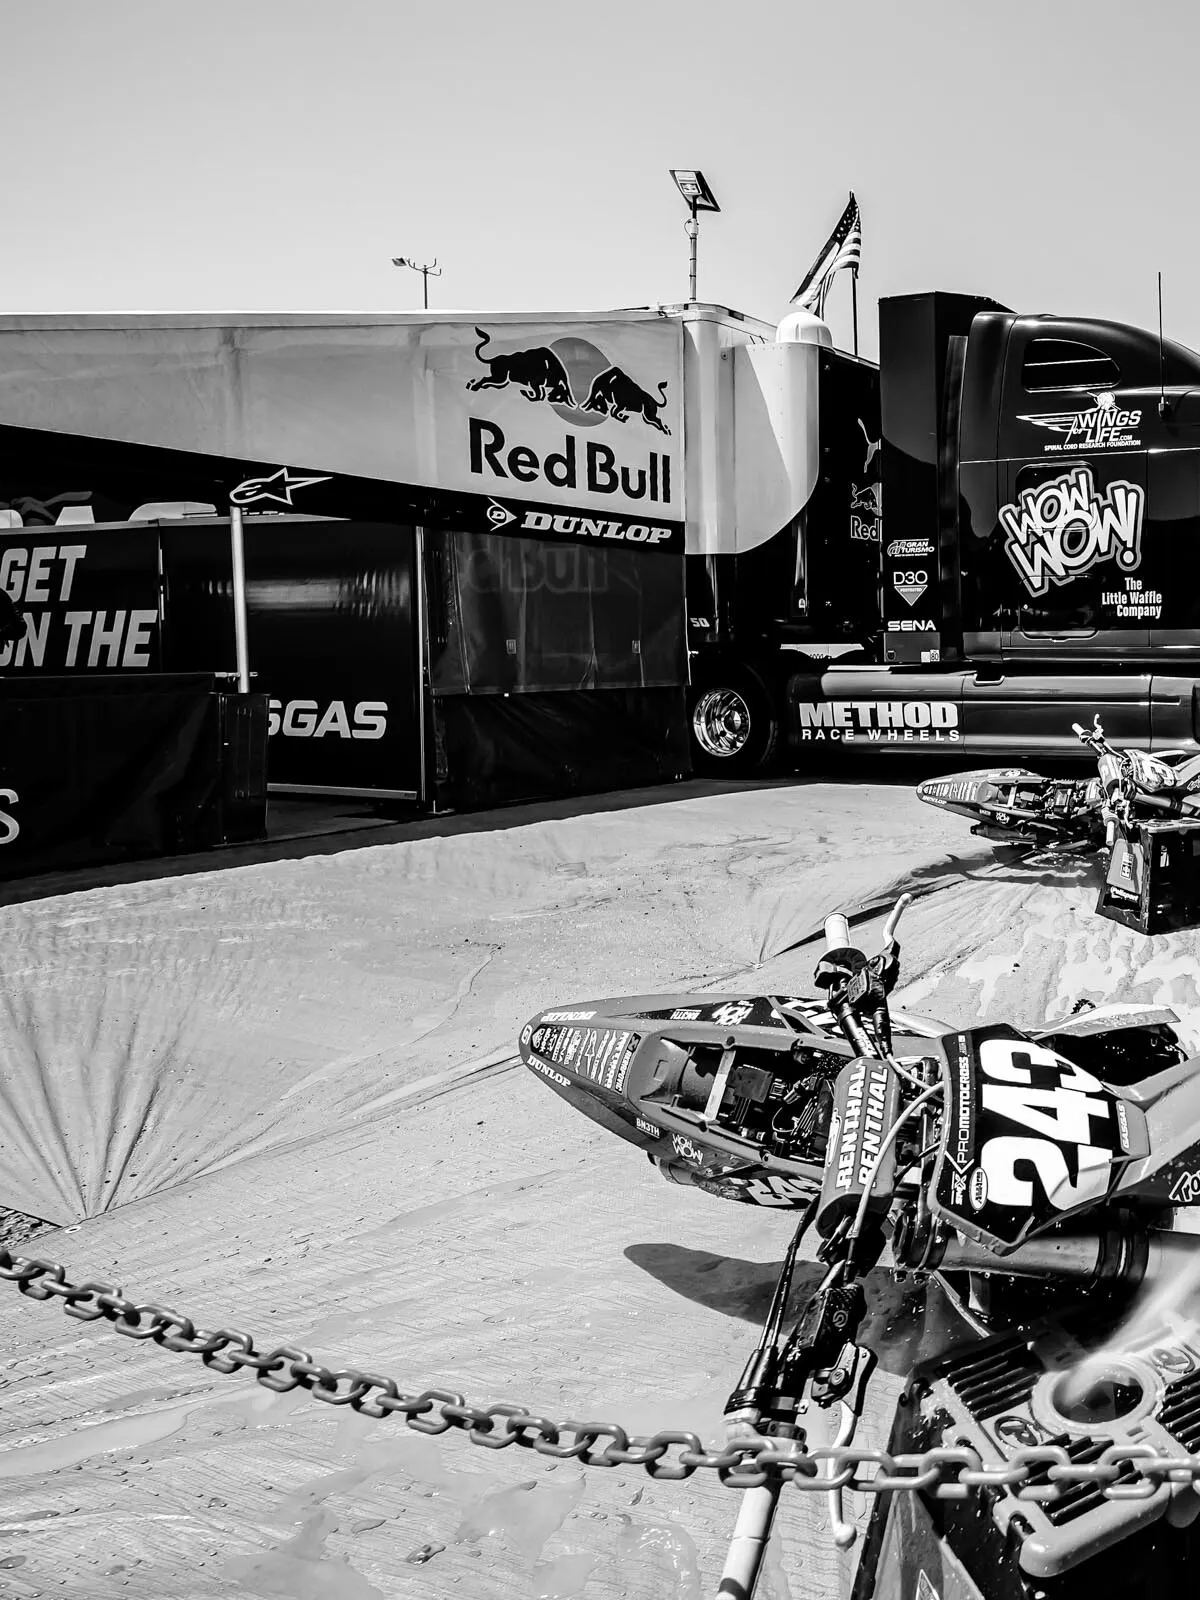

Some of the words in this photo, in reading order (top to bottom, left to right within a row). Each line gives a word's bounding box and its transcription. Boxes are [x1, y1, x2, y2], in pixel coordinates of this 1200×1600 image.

[1078, 410, 1142, 427] WINGS
[1078, 441, 1106, 449] RESEARCH
[469, 416, 577, 489] Red
[586, 441, 671, 503] Bull
[520, 510, 672, 544] DUNLOP
[850, 515, 880, 541] Red
[901, 546, 935, 554] TURISMO
[0, 544, 87, 602] GET
[1124, 577, 1143, 591] The
[1101, 592, 1128, 605] Little
[1129, 591, 1162, 605] Waffle
[690, 617, 710, 628] 50
[887, 620, 936, 631] SENA
[1116, 605, 1162, 620] Company
[64, 609, 158, 667] THE
[799, 701, 958, 727] METHOD
[801, 729, 854, 740] RACE
[867, 729, 960, 741] WHEELS
[527, 1055, 571, 1087] DUNLOP
[635, 1117, 660, 1138] BN3TH
[836, 1064, 868, 1190] RENTHAL
[857, 1066, 888, 1188] RENTHAL
[979, 1039, 1113, 1210] 243
[1118, 1104, 1130, 1149] GASGAS
